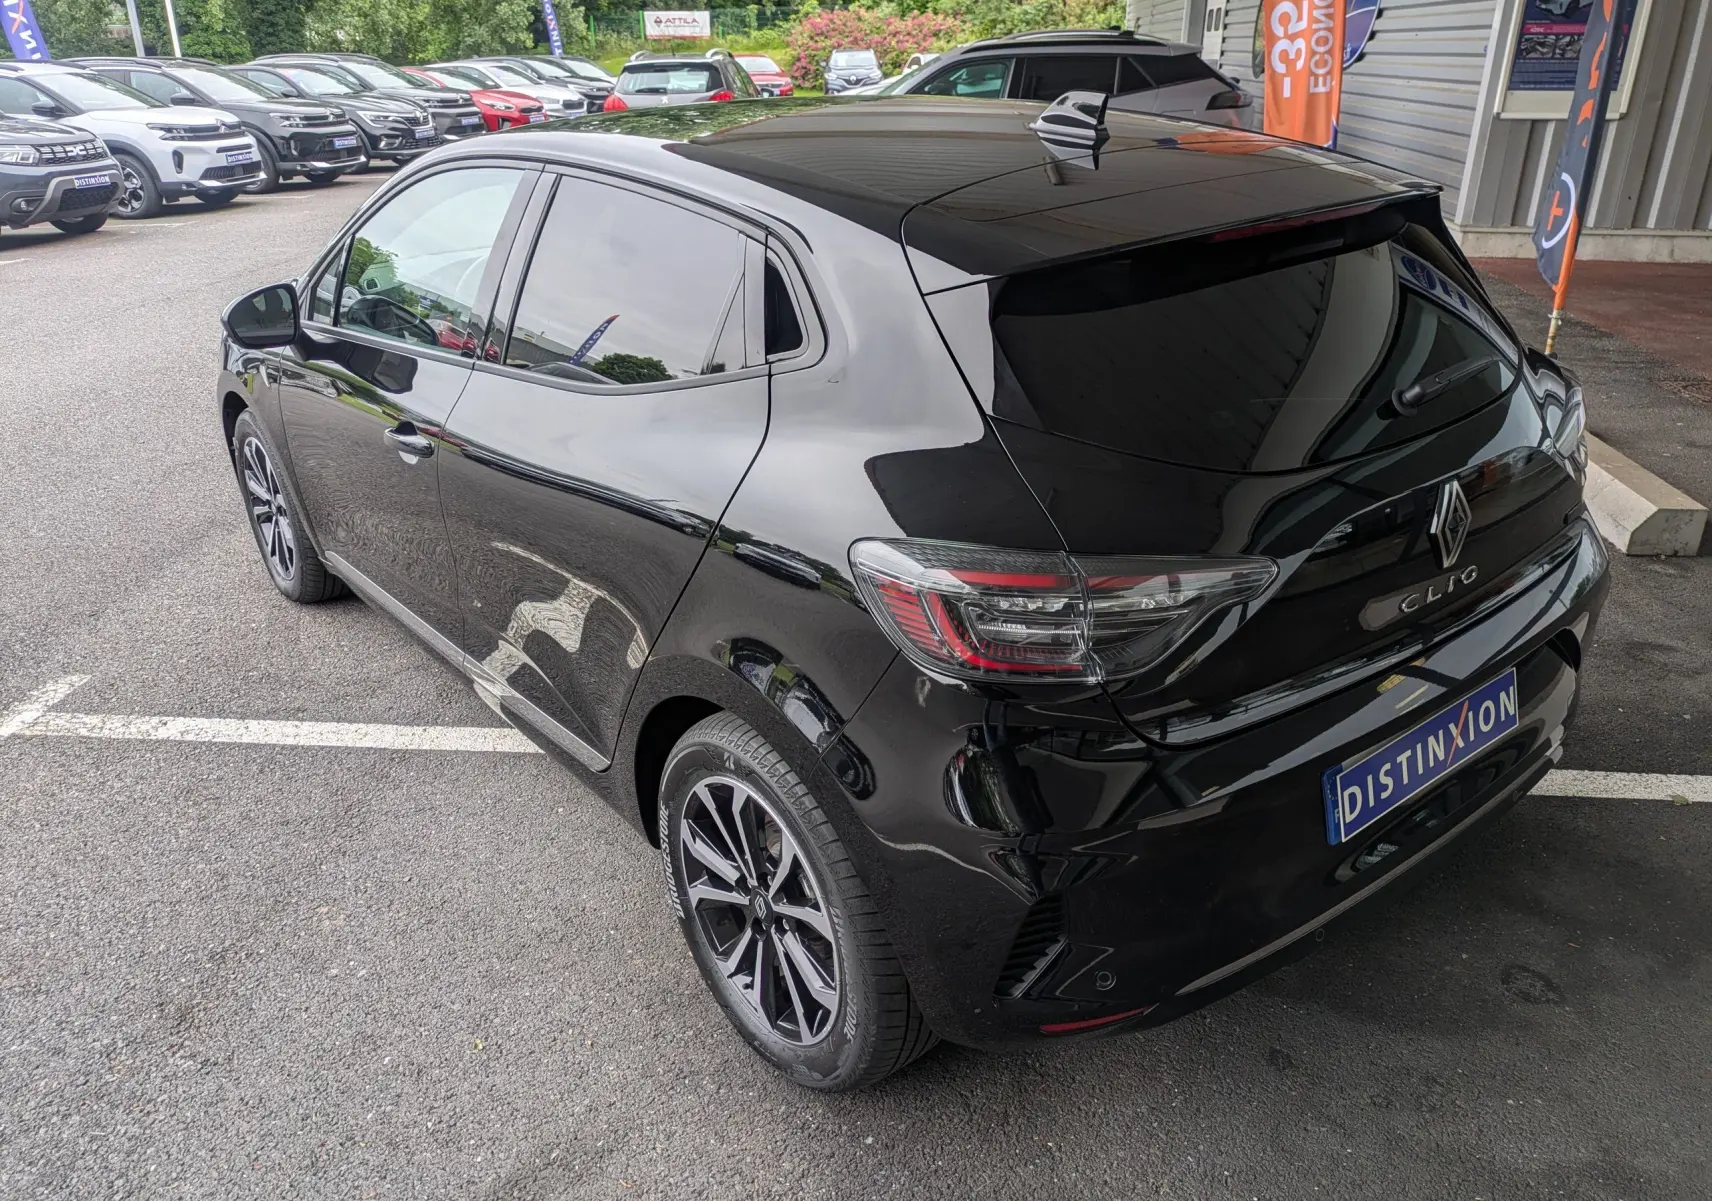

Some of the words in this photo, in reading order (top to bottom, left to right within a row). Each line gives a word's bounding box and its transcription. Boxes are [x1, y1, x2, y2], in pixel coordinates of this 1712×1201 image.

[664, 17, 700, 25] ATTILA
[228, 153, 253, 163] DISTINXION
[75, 174, 110, 188] DISTINXION
[1400, 564, 1479, 613] CLIO
[1342, 685, 1516, 824] DISTINXION
[660, 799, 686, 920] BRIDGESTONE
